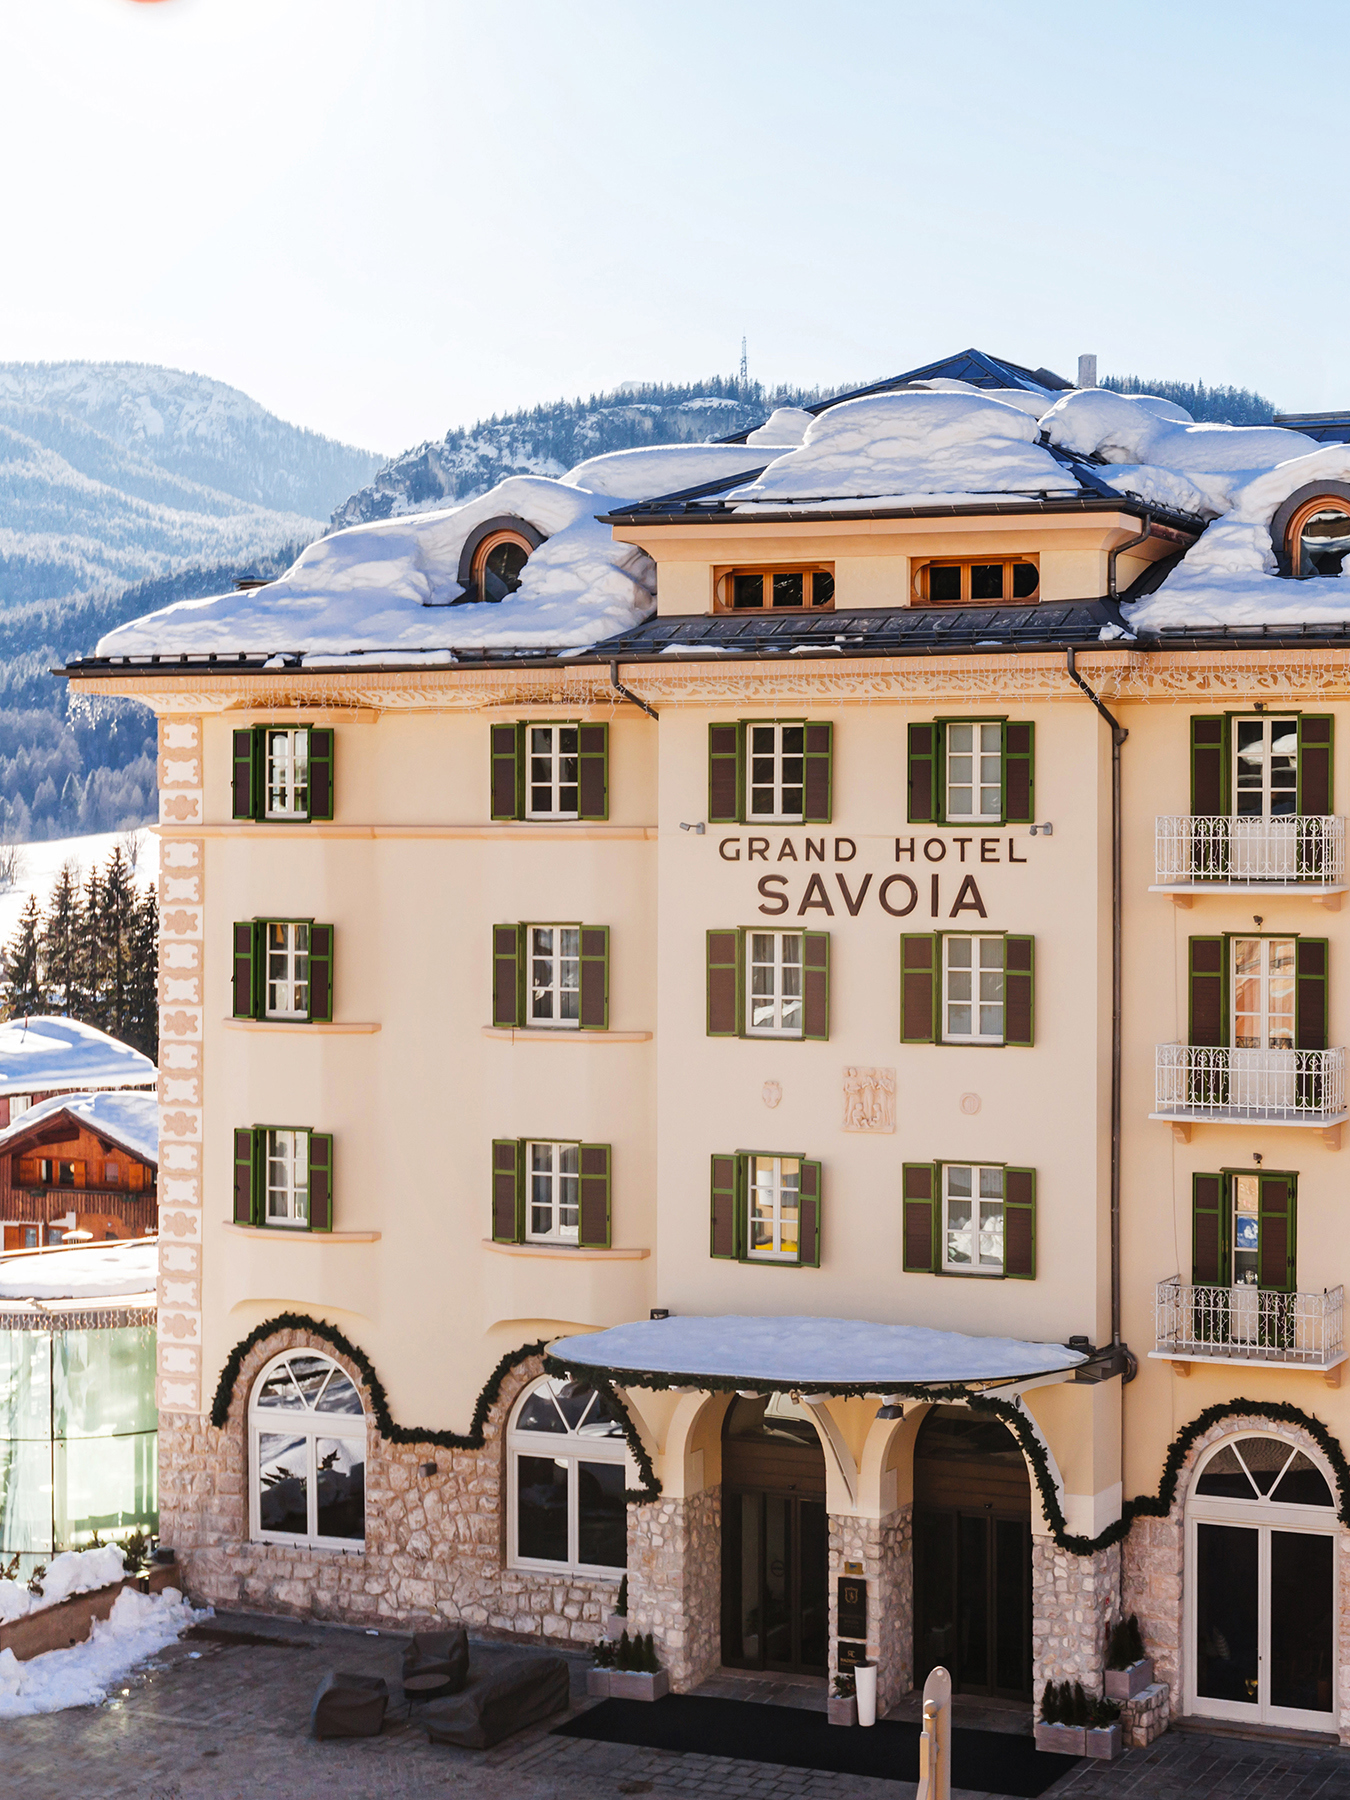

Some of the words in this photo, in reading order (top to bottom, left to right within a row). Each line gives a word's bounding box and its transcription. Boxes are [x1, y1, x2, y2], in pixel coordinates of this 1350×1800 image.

[718, 837, 857, 862] GRAND
[895, 837, 1028, 863] HOTEL
[757, 872, 988, 919] SAVOIA
